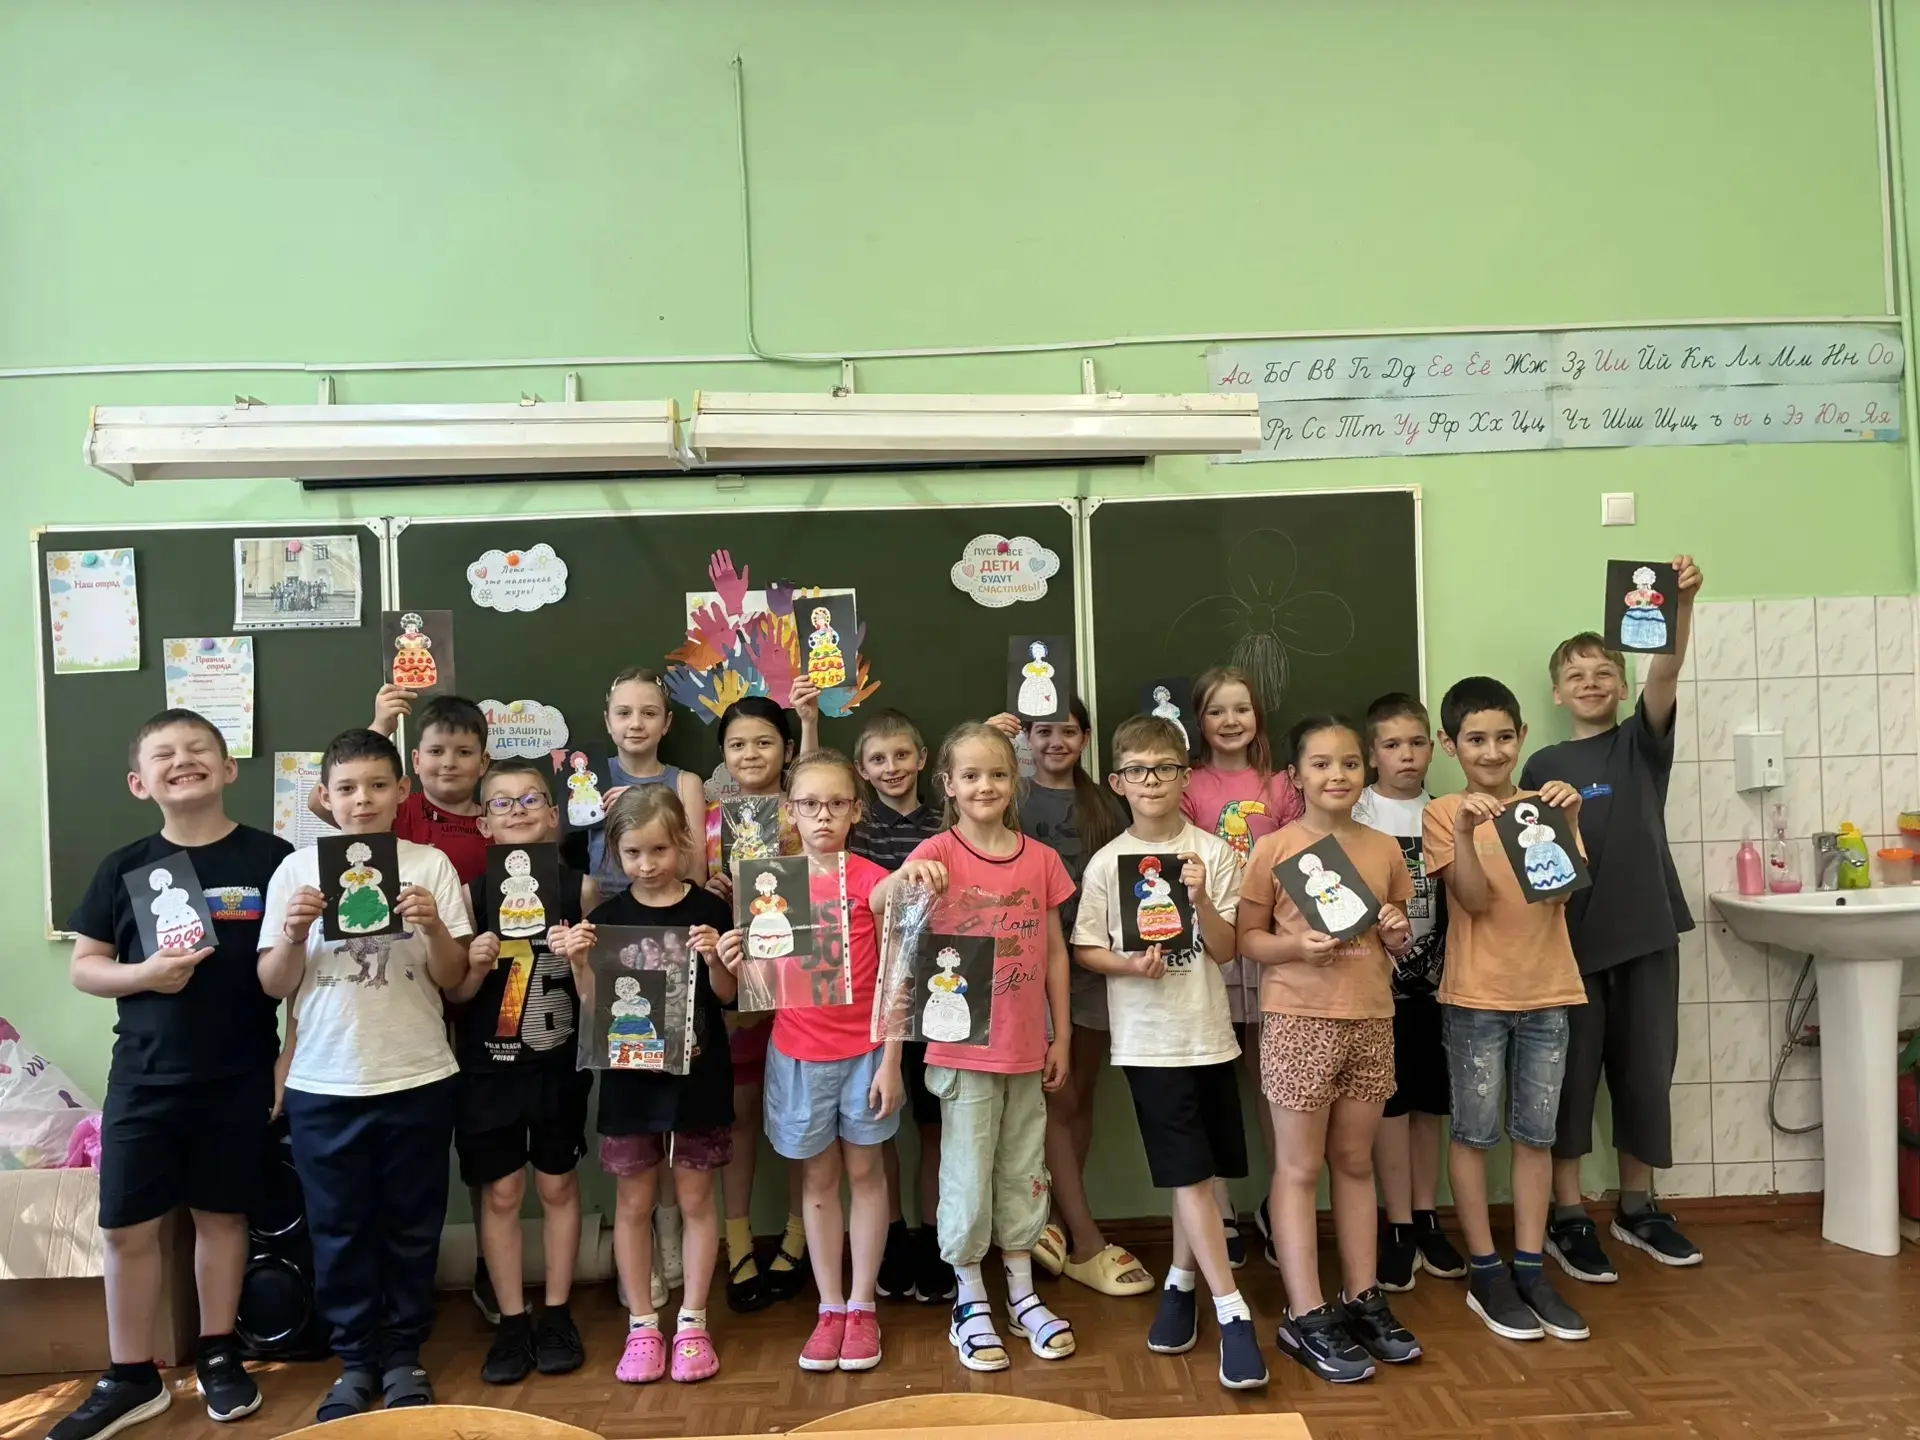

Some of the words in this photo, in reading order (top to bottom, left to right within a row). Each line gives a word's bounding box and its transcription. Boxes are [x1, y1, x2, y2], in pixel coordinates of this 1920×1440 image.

[1218, 363, 1252, 386] Аа
[1264, 361, 1301, 383] Бб
[1307, 358, 1336, 381] Вв
[1349, 357, 1372, 379] Гг
[1382, 357, 1416, 387] Дд
[1427, 355, 1453, 377] Ее
[1466, 352, 1491, 376] Ёё
[1504, 353, 1548, 375] Жж
[1562, 350, 1586, 380] Зз
[1594, 349, 1629, 371] Ии
[1638, 344, 1672, 371] Йй
[1680, 348, 1716, 369] Кк
[1725, 344, 1761, 368] Лл
[1768, 345, 1813, 368] Мм
[1821, 343, 1859, 366] Нн
[1867, 342, 1894, 365] Оо
[1263, 418, 1293, 450] Рр
[1301, 416, 1326, 439] Сс
[1335, 414, 1385, 438] Тт
[1394, 413, 1420, 445] Уу
[1428, 412, 1460, 442] Фф
[1468, 411, 1503, 432] Хх
[1511, 410, 1546, 433] Цц
[1562, 408, 1591, 430] Чч
[1602, 407, 1644, 429] Шш
[1654, 407, 1699, 431] Щщ
[1710, 414, 1722, 427] ъ
[1733, 413, 1752, 426] ы
[1763, 414, 1772, 425] ь
[1781, 404, 1804, 425] Ээ
[1814, 402, 1850, 425] Юю
[1860, 401, 1891, 424] Яя
[979, 560, 1020, 573] ДЕТИ
[74, 580, 93, 589] Наш
[505, 576, 551, 585] маленькая
[981, 575, 1012, 583] БУДУТ
[978, 581, 1041, 594] СЧАСТЛИВЫ!
[484, 708, 497, 725] 1
[497, 713, 536, 724] ИЮНЯ
[487, 727, 506, 736] ЕНЬ
[496, 737, 541, 749] ДЕТЕЙ!
[298, 768, 321, 776] Списо
[983, 912, 1040, 940] Happy
[1167, 933, 1205, 967] ECTIV
